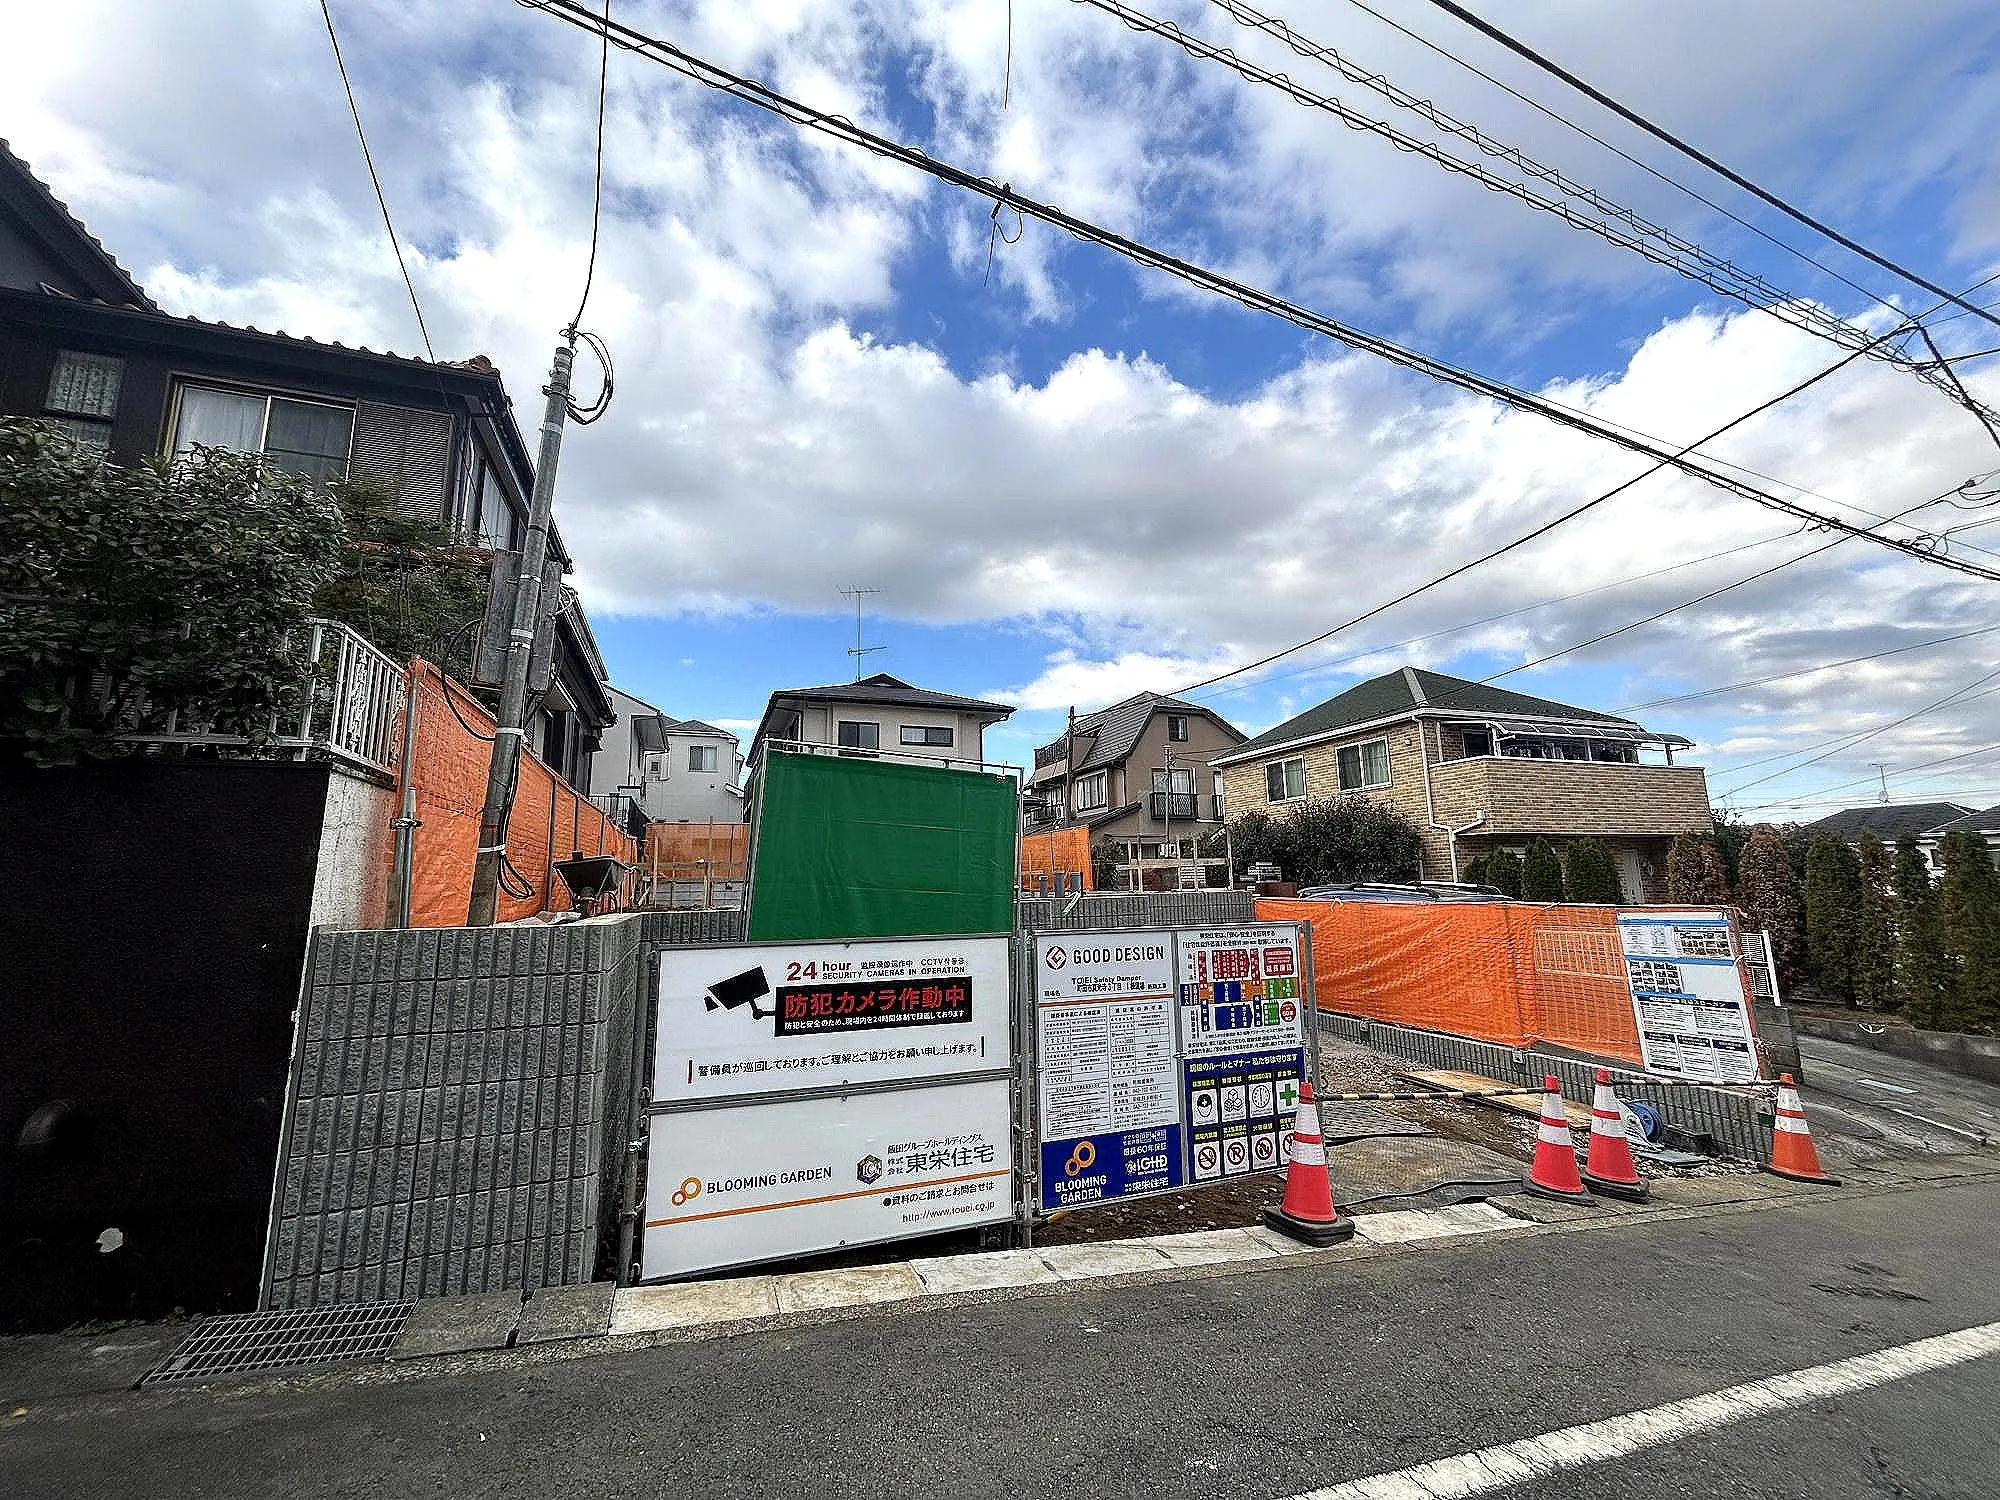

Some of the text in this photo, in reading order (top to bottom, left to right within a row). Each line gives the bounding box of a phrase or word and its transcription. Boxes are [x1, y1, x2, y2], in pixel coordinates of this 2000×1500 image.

[1073, 945, 1164, 964] GOOD DESIGN
[786, 961, 851, 982] 24 hour
[822, 965, 965, 980] SECURITY CAMERAS IN OPERATION
[1116, 975, 1142, 983] Damper
[784, 985, 965, 1019] 防犯カメラ作動中
[887, 1133, 983, 1154] 飯田グループホールディングス
[906, 1144, 995, 1174] 東栄住宅
[707, 1166, 832, 1194] BLOOMING GARDEN
[1055, 1175, 1107, 1193] BLOOMING
[1060, 1187, 1102, 1204] GARDEN
